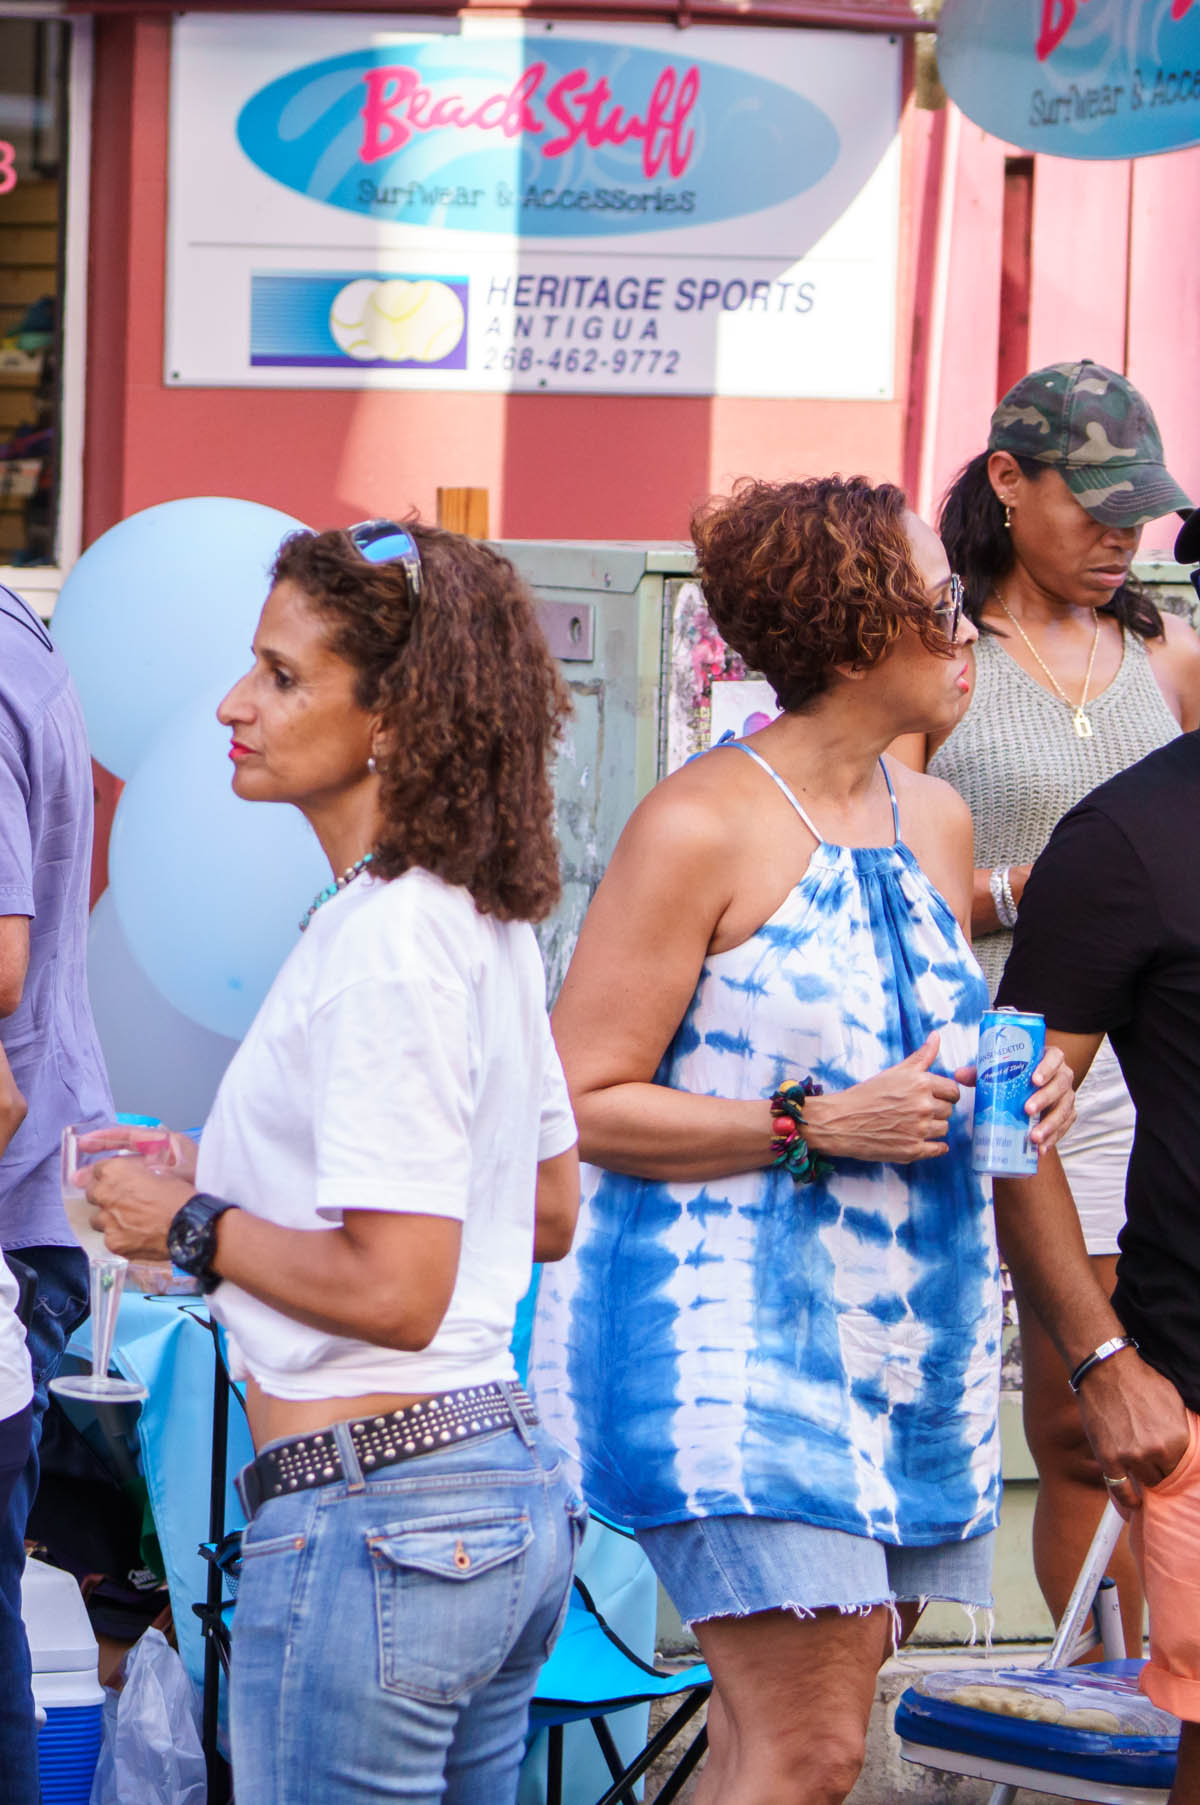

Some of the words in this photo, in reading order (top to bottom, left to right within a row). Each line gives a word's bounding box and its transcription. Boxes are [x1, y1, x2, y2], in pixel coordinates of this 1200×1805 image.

[358, 61, 545, 164] Beach
[541, 64, 699, 180] Stuff
[522, 183, 696, 214] Accessories
[487, 275, 665, 311] HERITAGE
[674, 278, 816, 314] SPORTS
[485, 315, 659, 341] ANTIGUA
[483, 347, 681, 375] 268-462-9772
